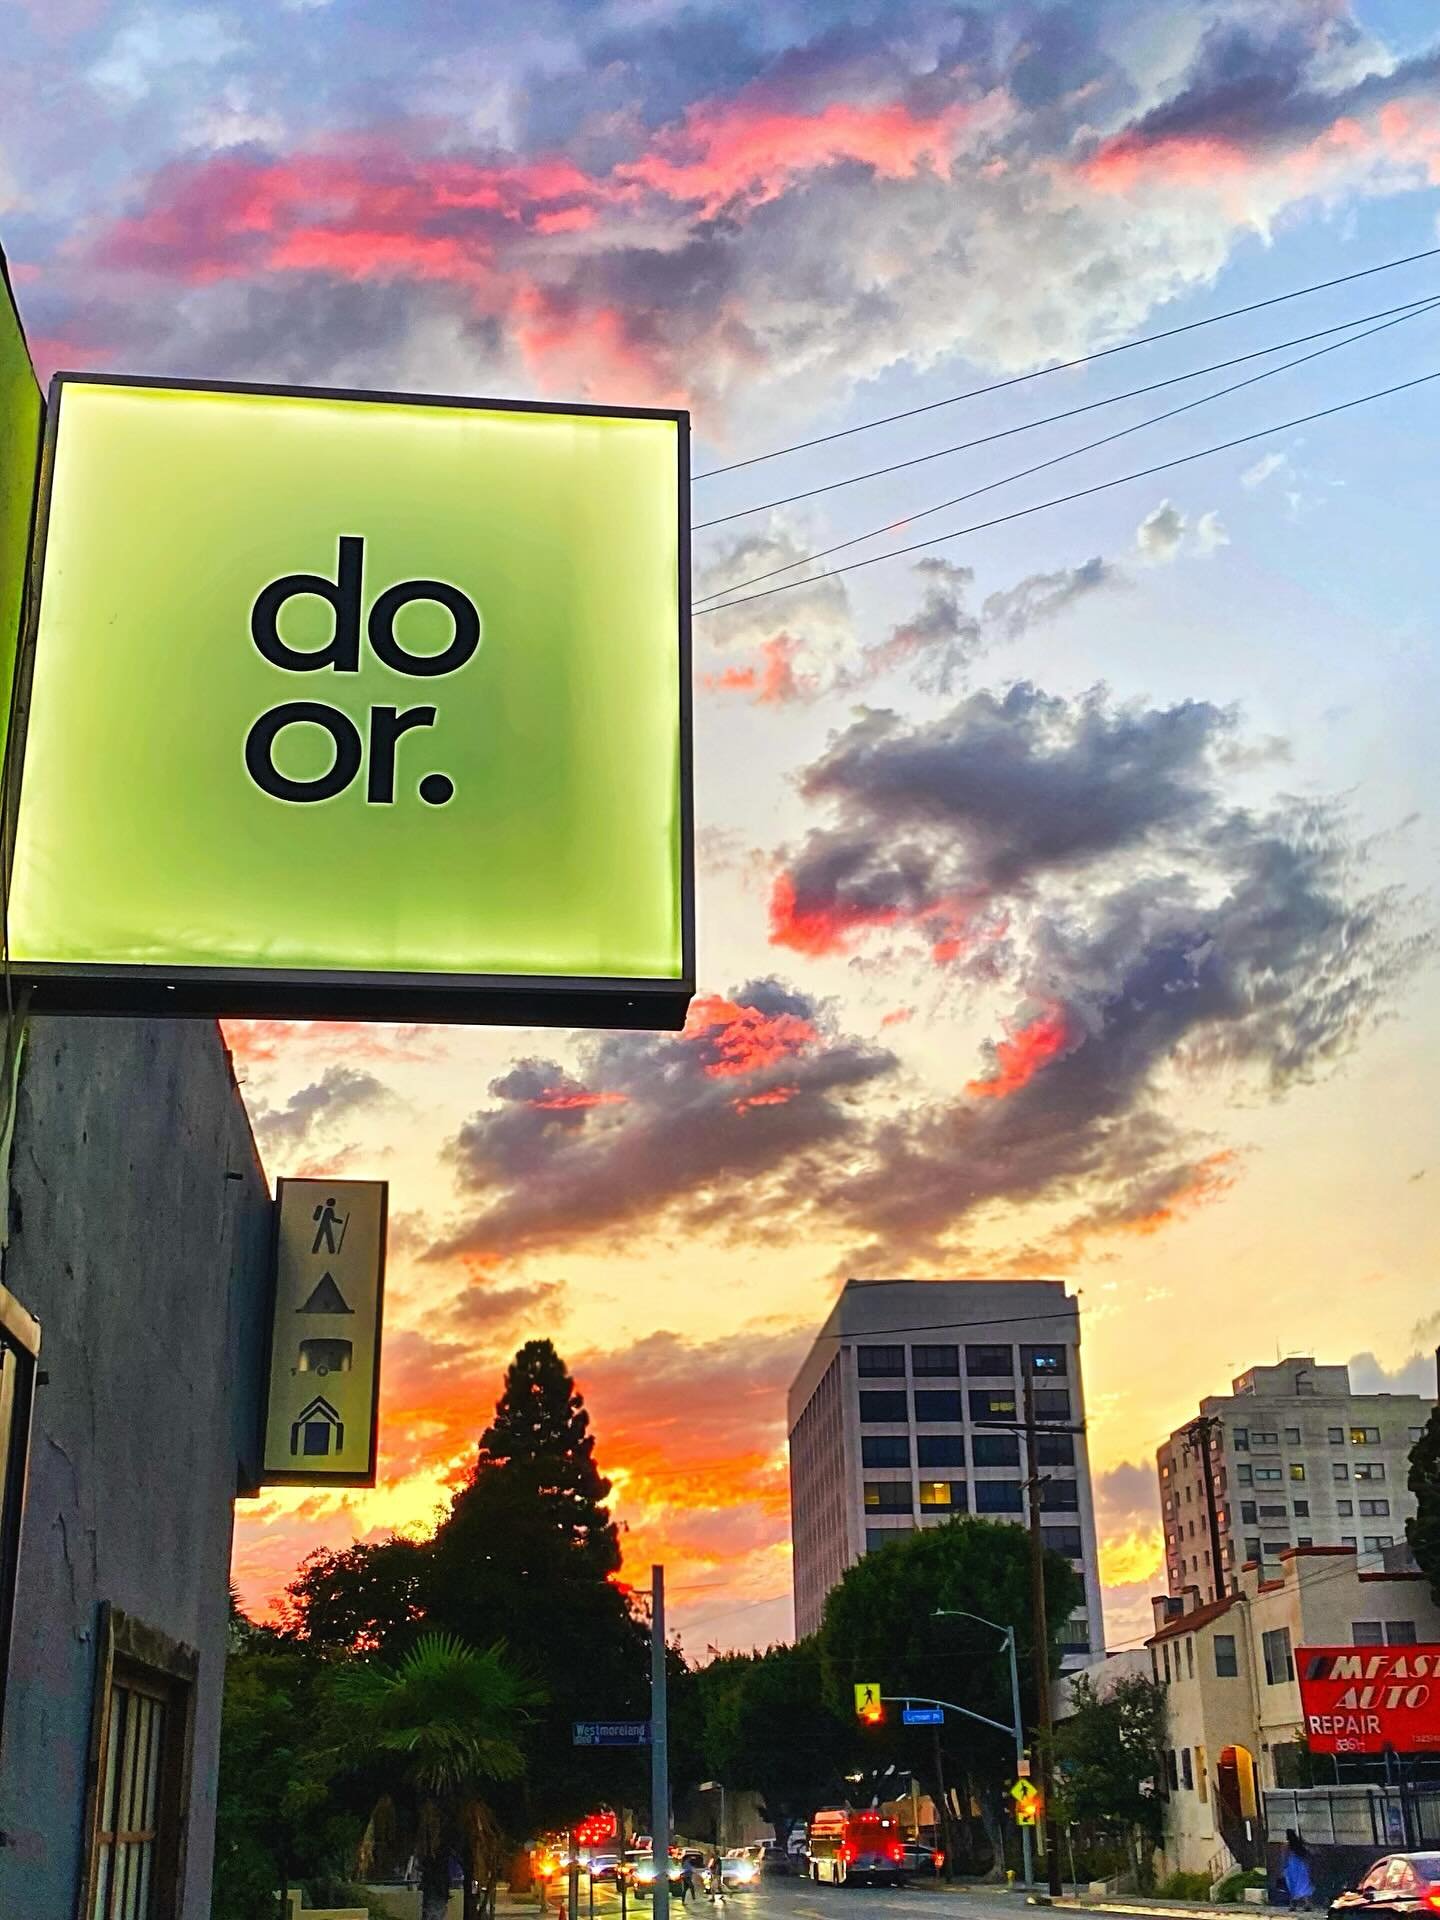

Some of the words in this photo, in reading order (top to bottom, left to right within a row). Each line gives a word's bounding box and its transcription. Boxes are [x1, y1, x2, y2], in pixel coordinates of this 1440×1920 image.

[251, 535, 481, 677] do
[245, 701, 454, 805] or.
[1333, 1684, 1430, 1710] AUTO
[576, 1724, 645, 1736] Westmoreland
[1309, 1715, 1381, 1735] REPAIR
